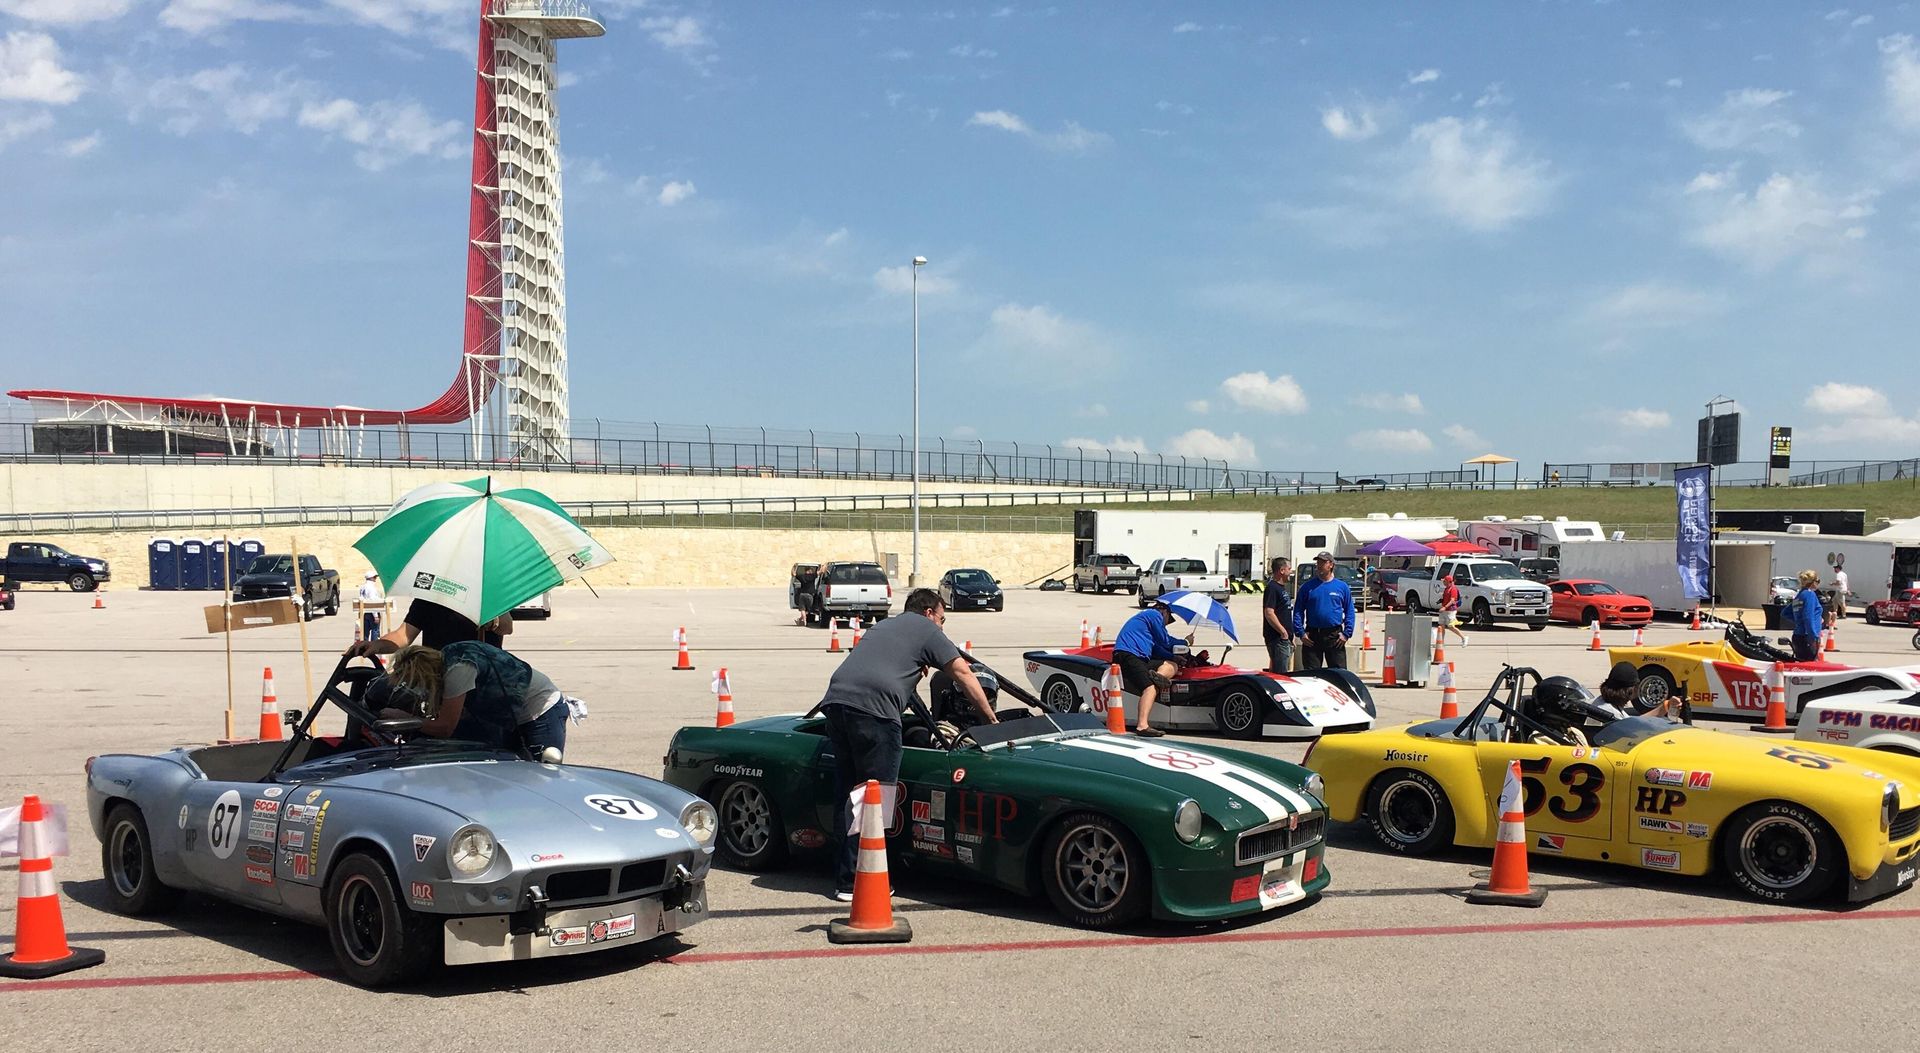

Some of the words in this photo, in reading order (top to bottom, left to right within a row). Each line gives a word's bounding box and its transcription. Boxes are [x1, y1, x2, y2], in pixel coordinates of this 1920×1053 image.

[1026, 661, 1041, 674] SRF
[1323, 685, 1349, 706] 88
[1693, 692, 1719, 702] SRF
[1732, 680, 1767, 709] 173
[1819, 709, 1863, 728] PFM
[1148, 750, 1215, 769] 83
[1383, 749, 1429, 763] Hoosier
[714, 764, 763, 777] GOODYEAR
[254, 800, 278, 812] SCCA
[589, 798, 645, 815] 87
[1635, 786, 1687, 815] HP
[958, 789, 1018, 840] HP
[1640, 818, 1668, 830] HAWK
[1768, 805, 1821, 834] Hoosier
[212, 802, 240, 849] 87
[311, 815, 324, 860] CARRERA
[913, 840, 939, 853] HAWK
[1735, 870, 1788, 899] Hoosier
